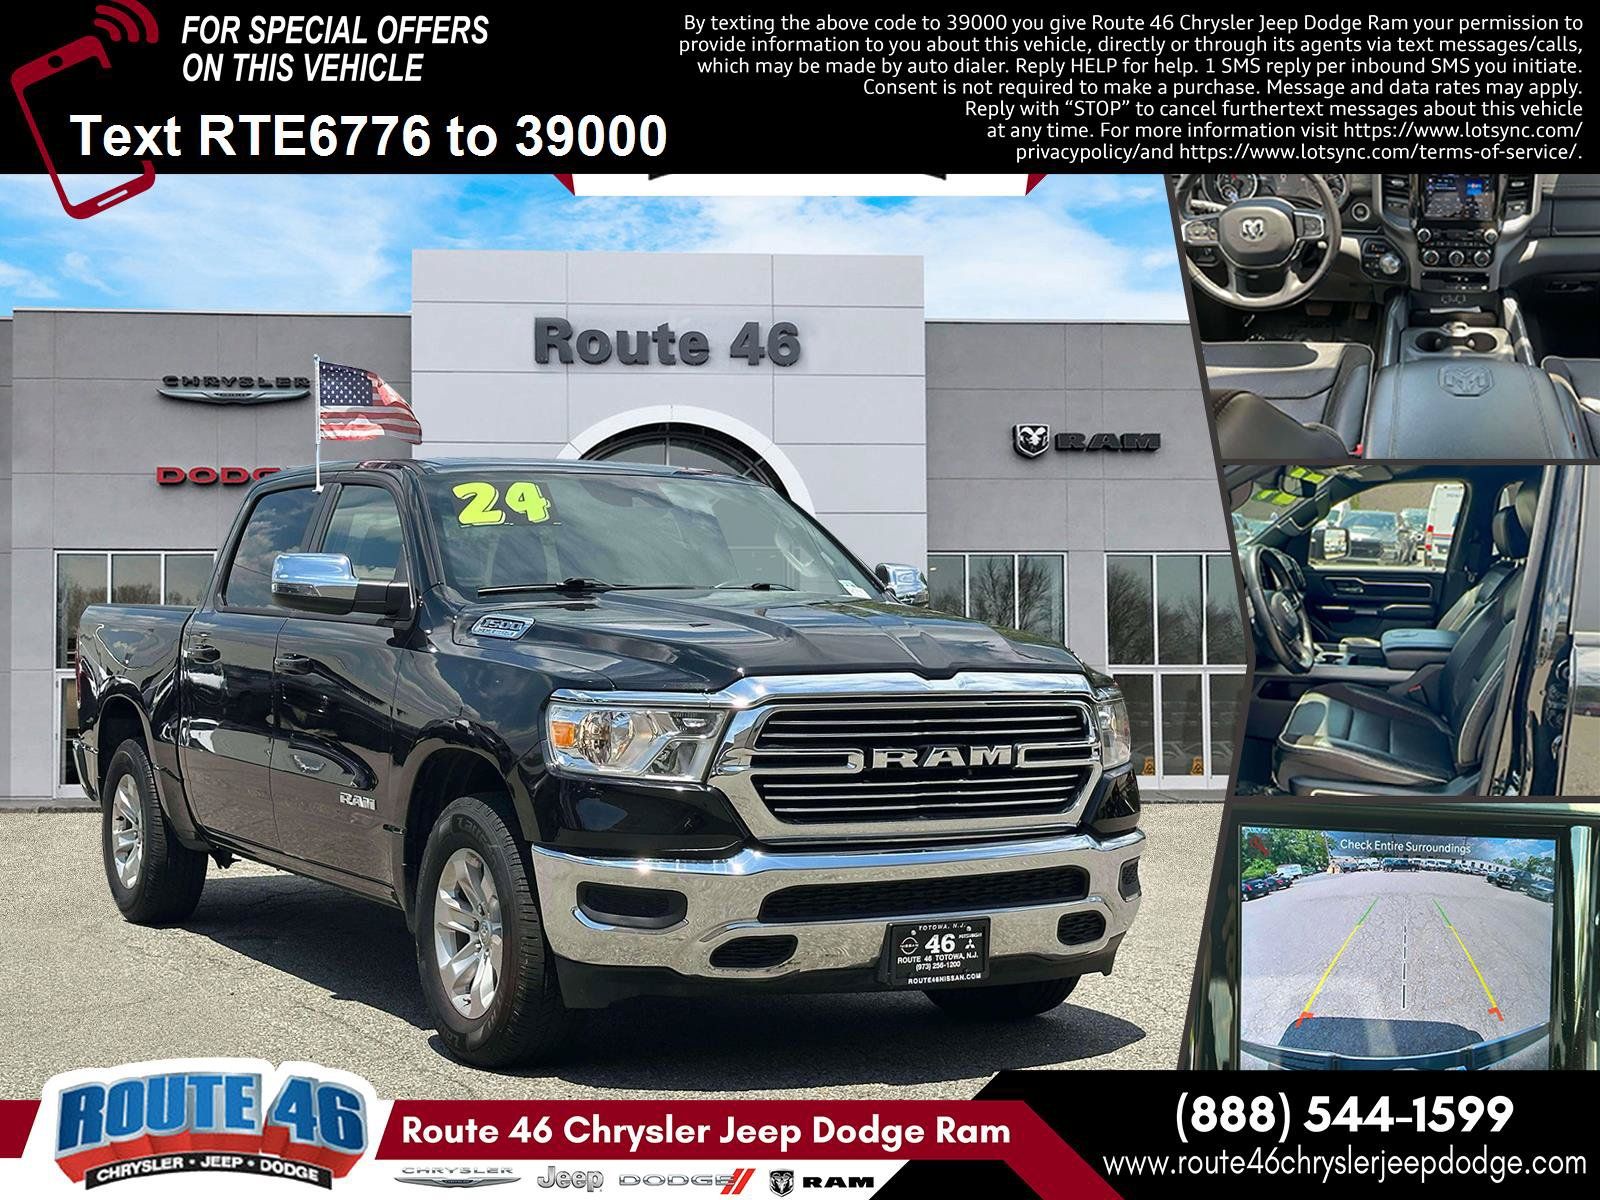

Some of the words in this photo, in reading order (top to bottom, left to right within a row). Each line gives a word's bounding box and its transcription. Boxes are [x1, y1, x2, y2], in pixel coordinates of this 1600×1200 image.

[534, 317, 710, 366] Route
[729, 322, 801, 367] 46
[162, 375, 311, 388] CHRYSLER
[1055, 433, 1161, 452] RAM
[452, 482, 551, 527] 24
[872, 745, 1012, 768] RAM
[339, 792, 376, 811] RAM
[1340, 839, 1372, 850] Check
[1374, 841, 1404, 851] Entire
[1405, 841, 1472, 855] Surroundings
[924, 933, 956, 954] 46
[897, 956, 921, 964] ROUTE
[916, 963, 931, 971] (973)
[908, 973, 981, 984] ROUTE46NISSAN.COM
